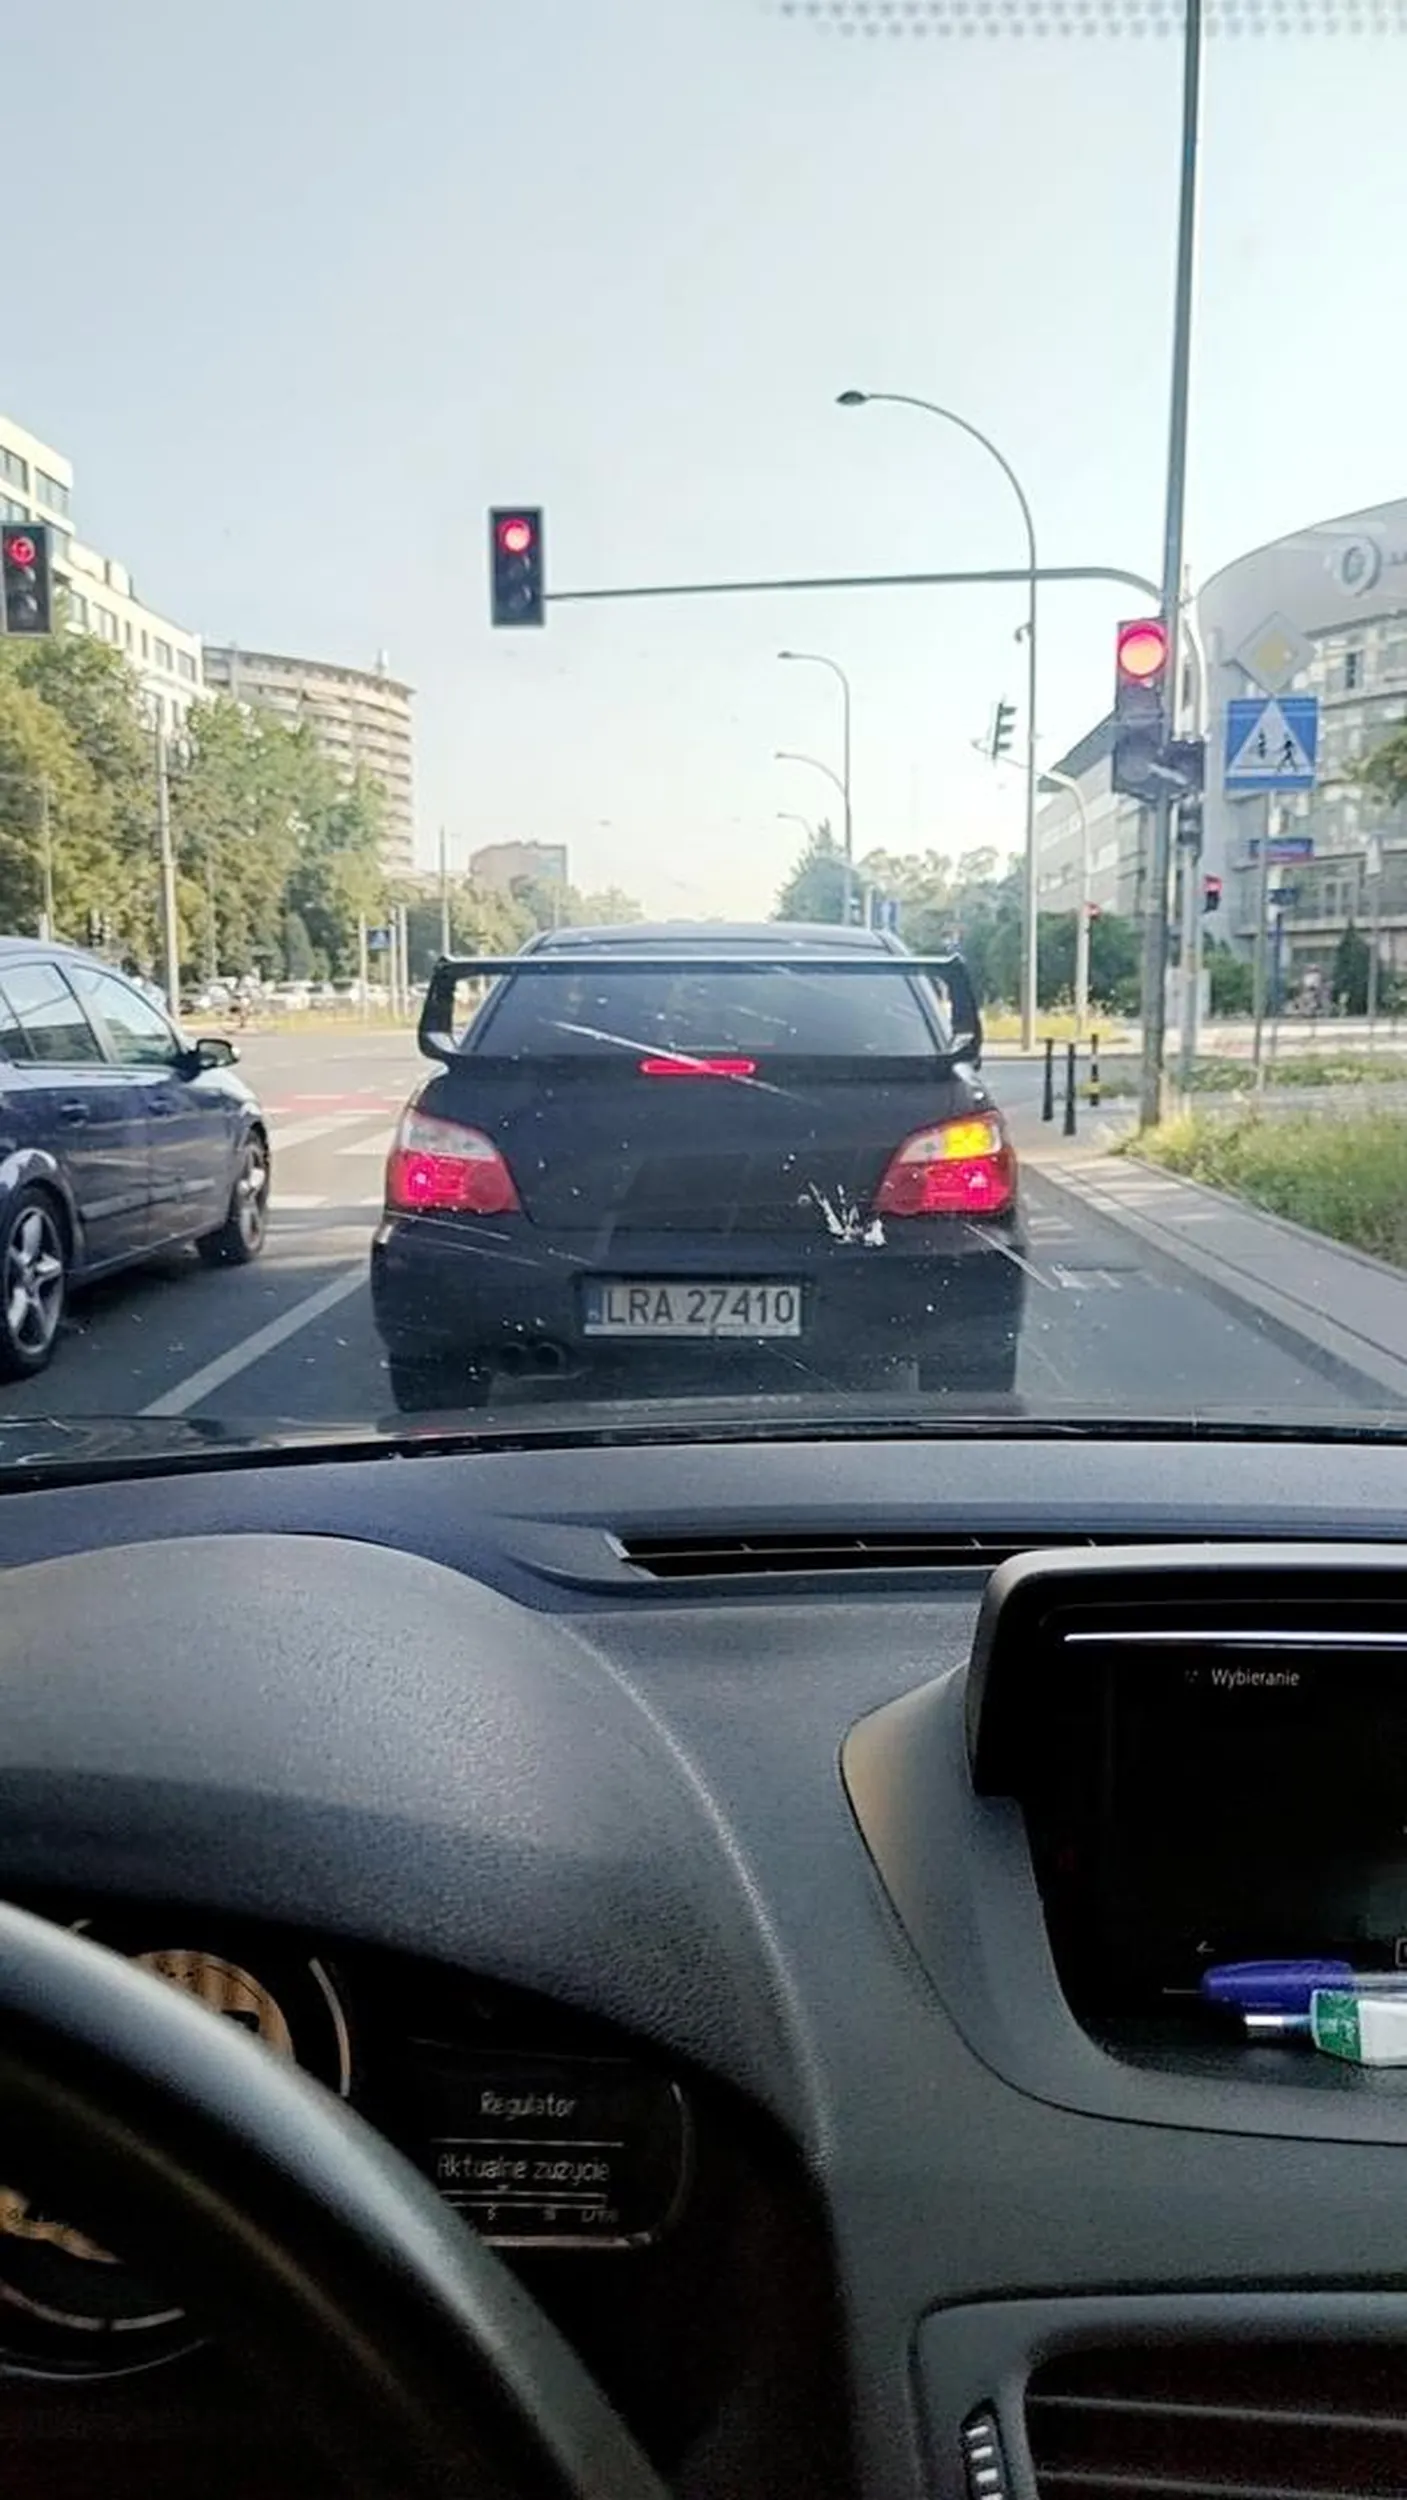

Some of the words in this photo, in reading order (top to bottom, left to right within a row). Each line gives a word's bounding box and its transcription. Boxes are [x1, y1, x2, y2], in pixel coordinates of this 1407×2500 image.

[606, 1288, 673, 1324] LRA
[687, 1289, 796, 1324] 27410
[1211, 1667, 1300, 1690] Wybieranie
[479, 2091, 576, 2120] Regulator
